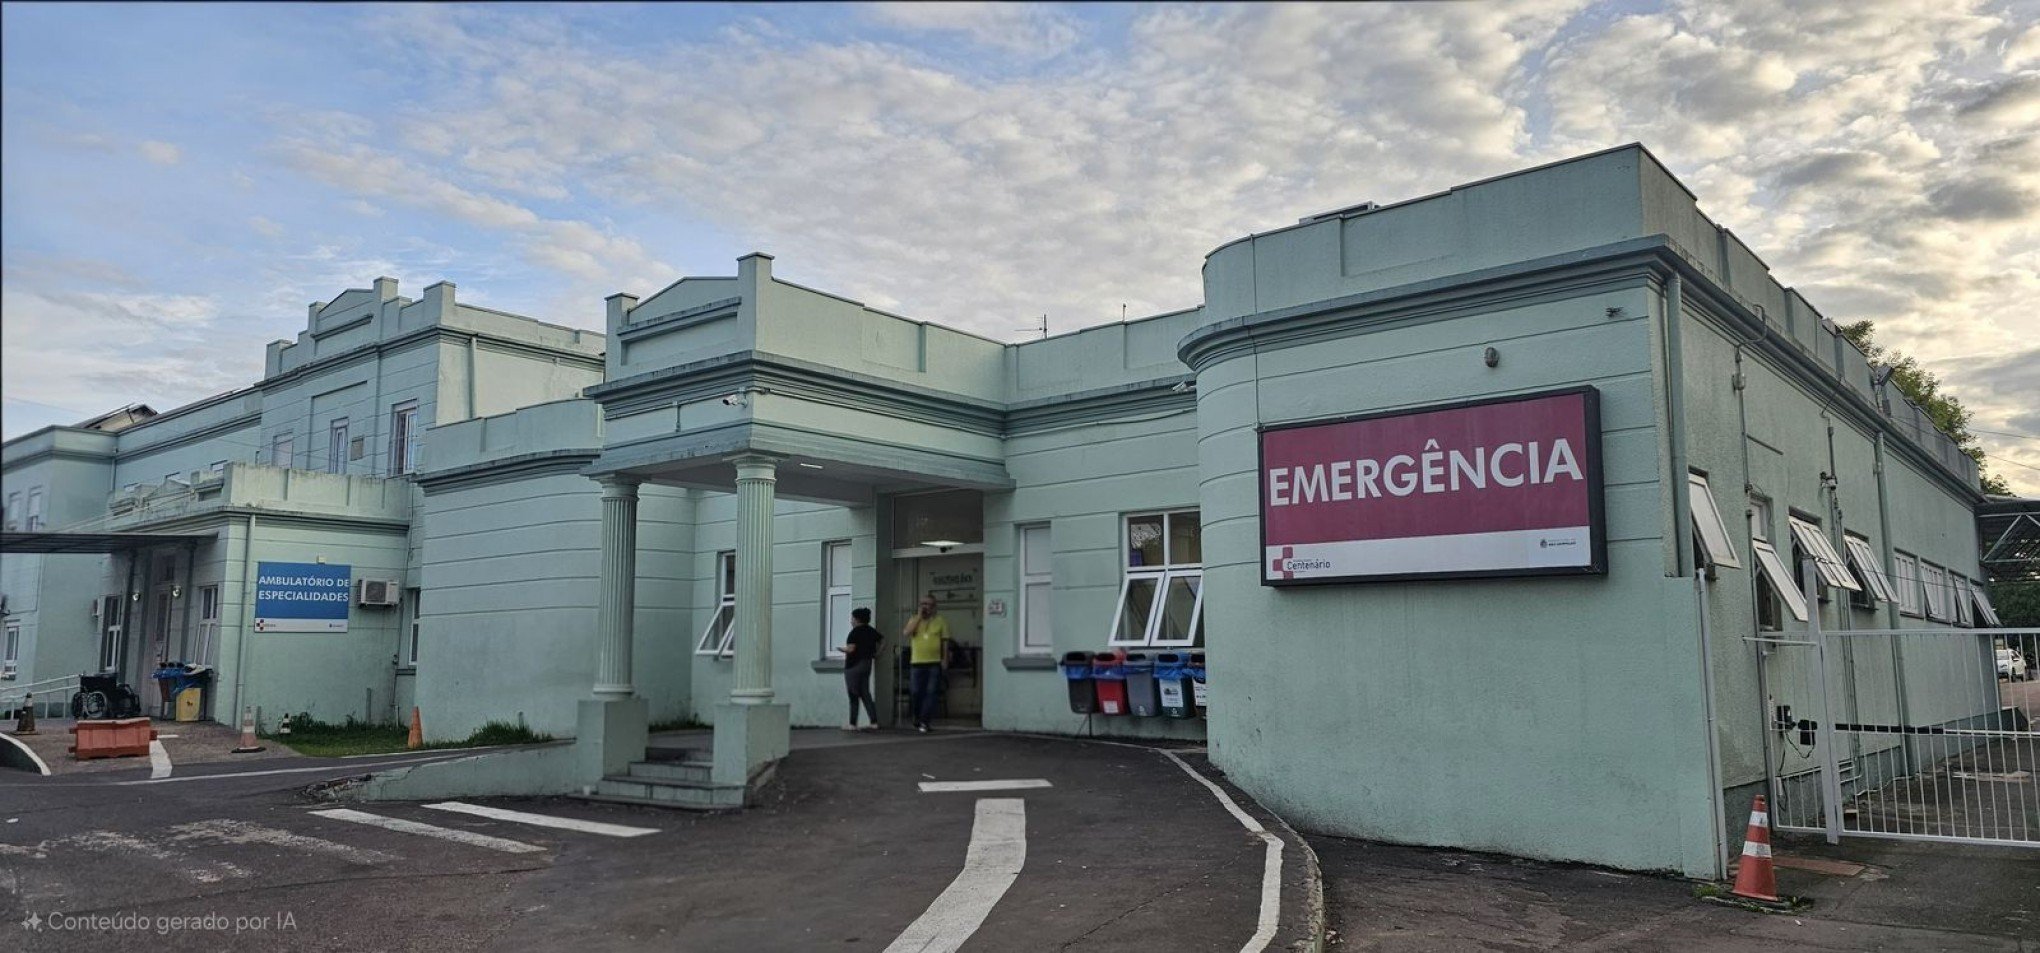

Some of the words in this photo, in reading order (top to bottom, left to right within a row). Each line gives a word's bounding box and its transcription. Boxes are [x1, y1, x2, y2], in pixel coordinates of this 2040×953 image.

[1269, 438, 1584, 507] EMERGÊNCIA
[1287, 559, 1331, 570] Centenário
[258, 575, 334, 587] AMBULATÓRIO
[337, 579, 350, 588] DE
[258, 590, 349, 602] ESPECIALIDADES
